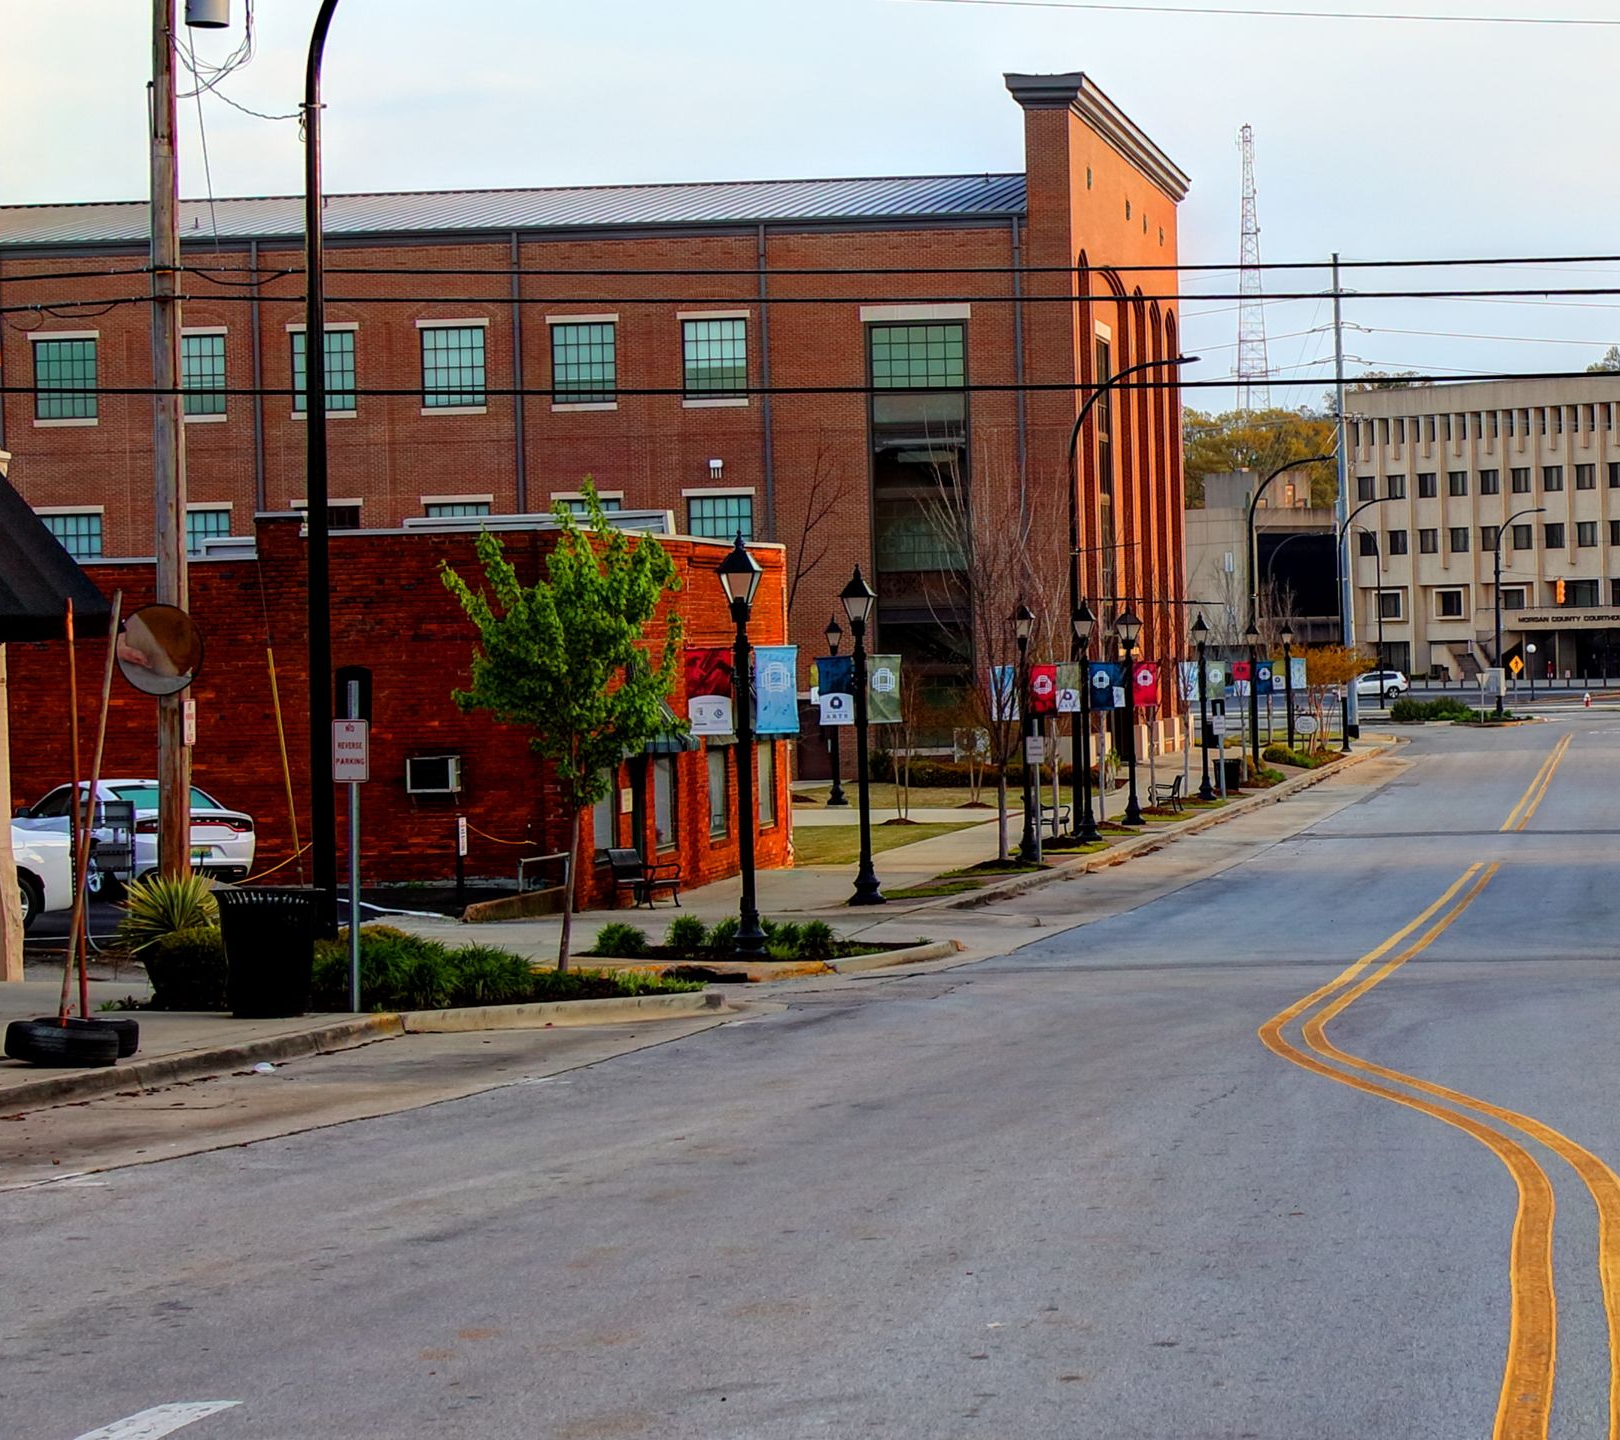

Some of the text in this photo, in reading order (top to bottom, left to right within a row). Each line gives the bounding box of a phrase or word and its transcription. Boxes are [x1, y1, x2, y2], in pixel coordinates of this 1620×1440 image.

[1551, 615, 1581, 623] COUNTY
[344, 723, 355, 733] NO
[337, 741, 363, 750] REVERSE
[335, 757, 365, 766] PARKING
